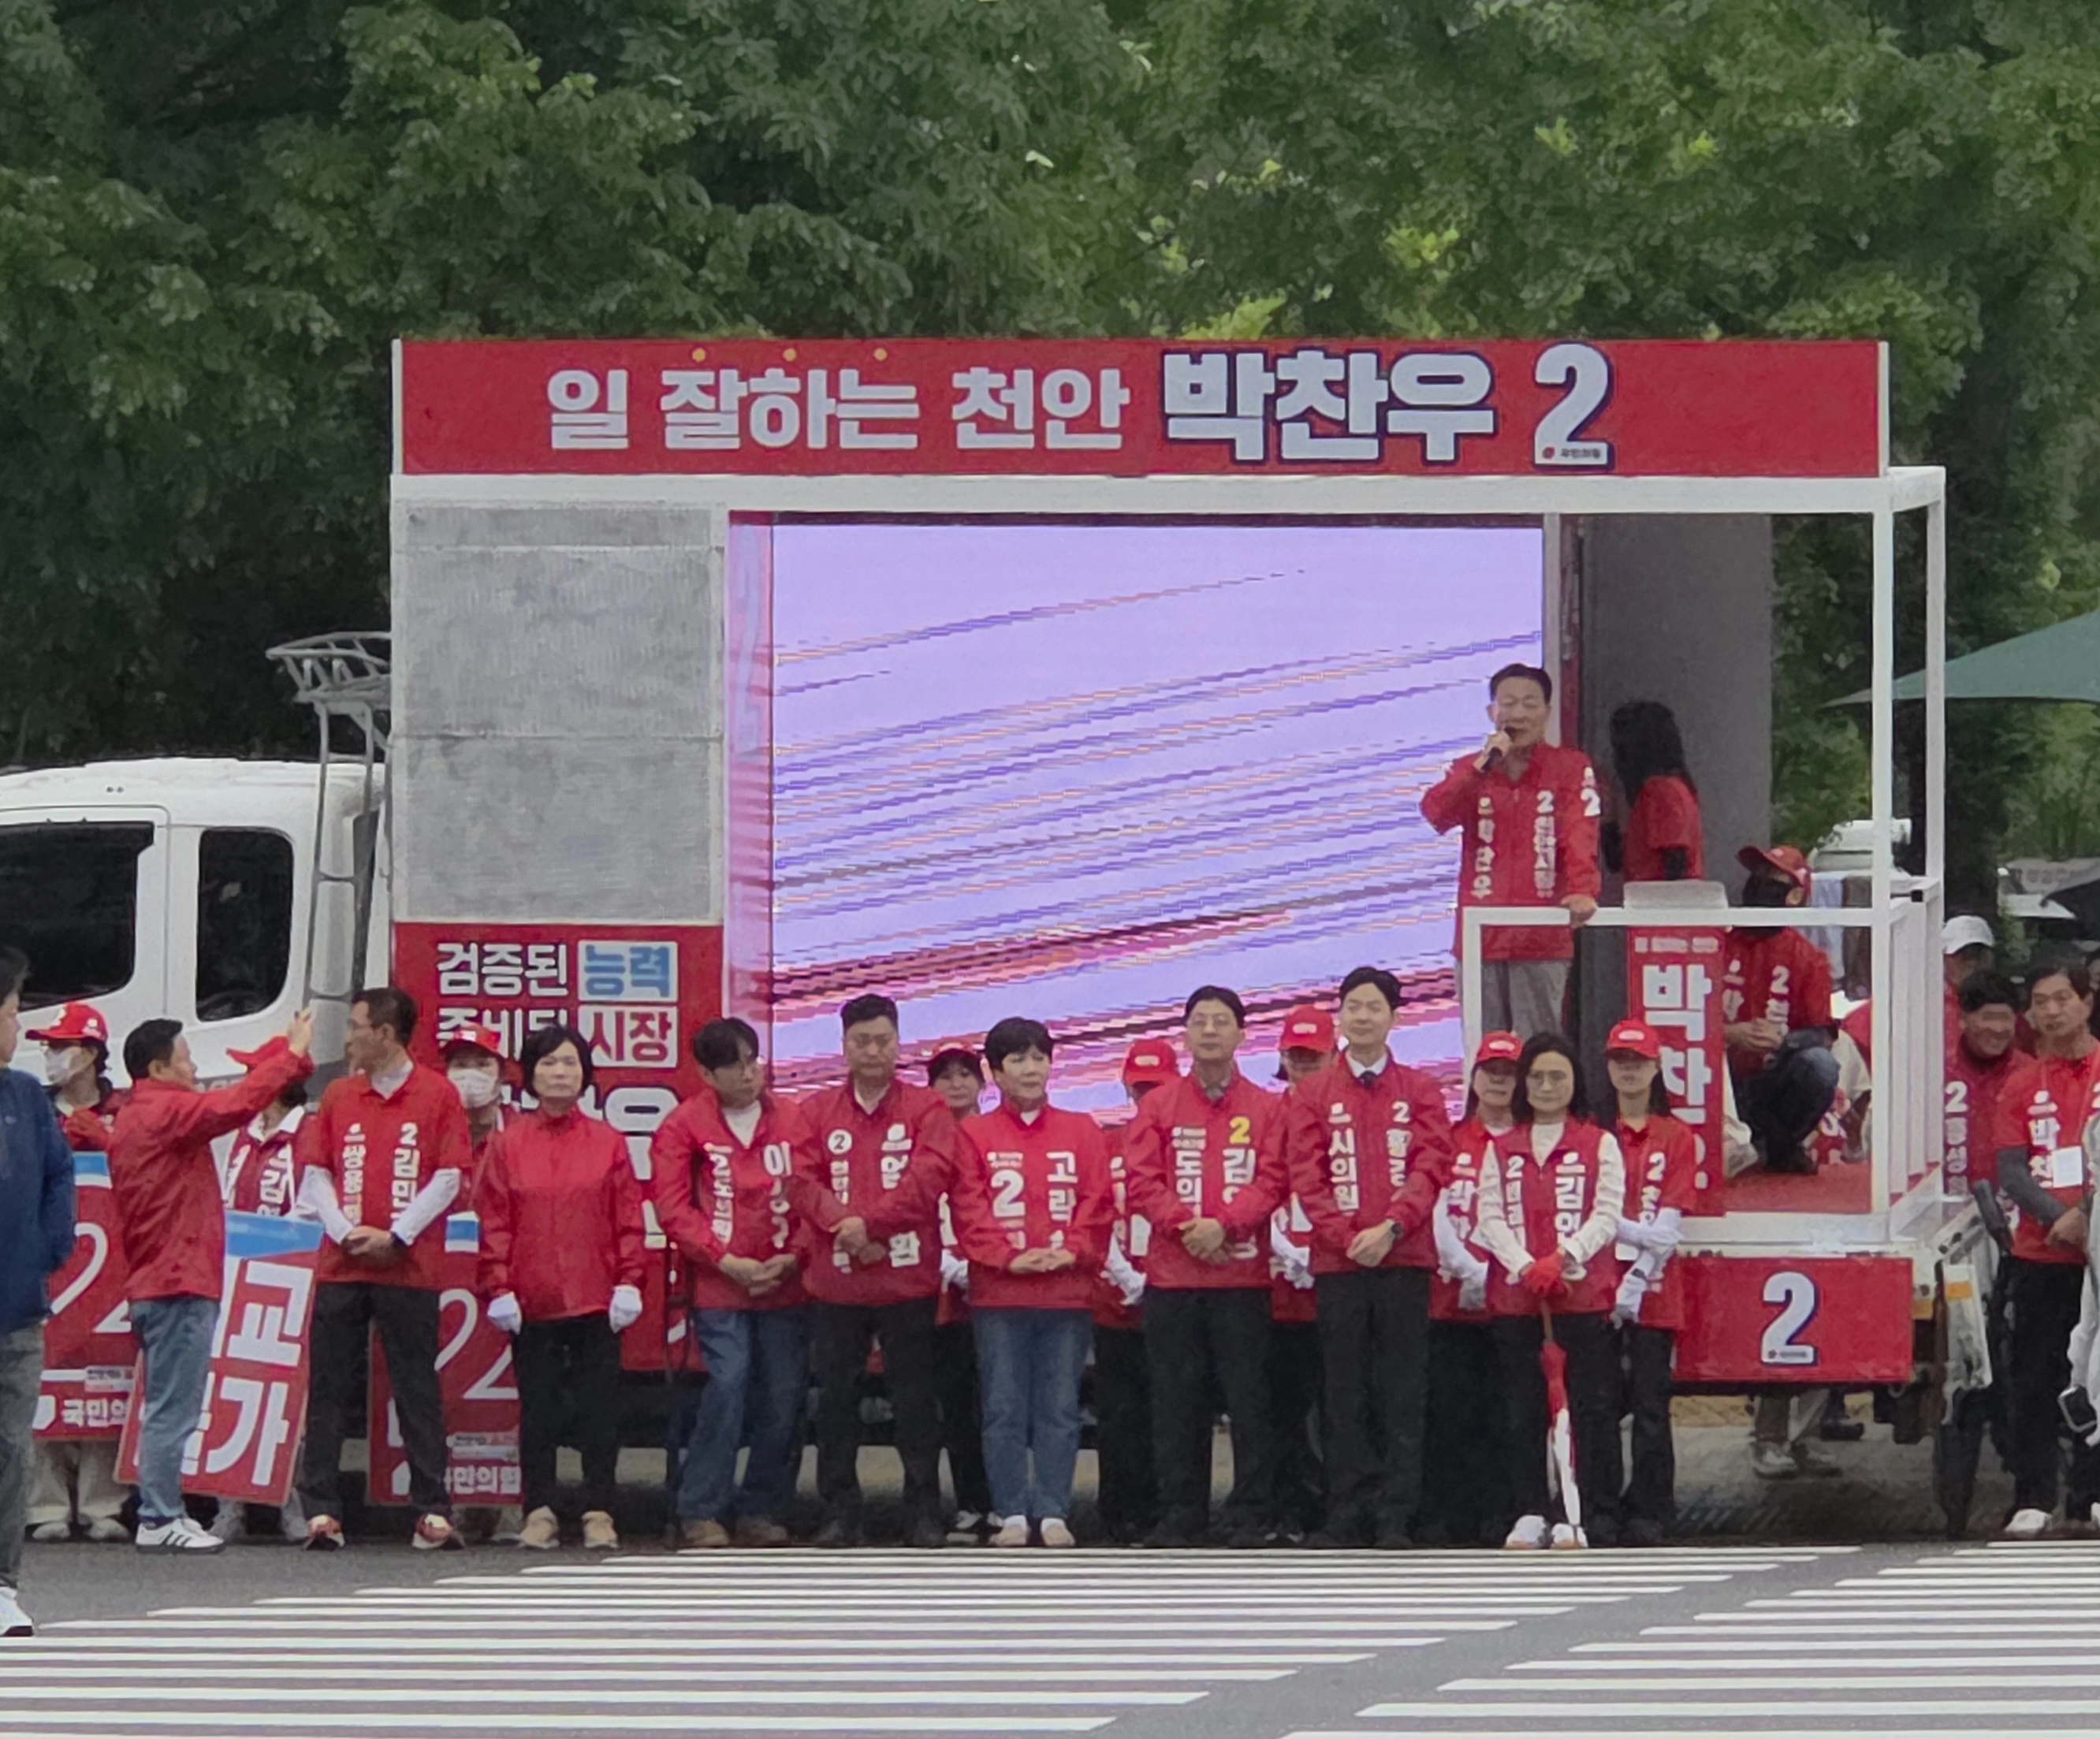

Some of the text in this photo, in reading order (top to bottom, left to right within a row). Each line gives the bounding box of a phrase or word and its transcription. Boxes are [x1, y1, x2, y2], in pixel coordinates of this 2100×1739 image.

[547, 342, 1611, 466] 일 잘하는 천안 박찬우 2
[1536, 790, 1555, 814] 2
[1580, 788, 1602, 817] 2
[436, 942, 671, 998] 검증된 능력
[1770, 965, 1790, 994] 2
[589, 1011, 673, 1063] 시장
[1944, 1081, 1969, 1113] 2
[1391, 1101, 1411, 1124] 2
[399, 1121, 419, 1146] 2
[1229, 1116, 1252, 1144] 2
[1327, 1126, 1360, 1212] 시의원
[1506, 1155, 1525, 1179] 2
[1646, 1151, 1666, 1181] 2
[990, 1169, 1026, 1218] 2
[1175, 1150, 1203, 1218] 도의
[1760, 1270, 1818, 1365] 2
[61, 1398, 128, 1427] 국민의
[445, 1465, 521, 1494] 민의힘
